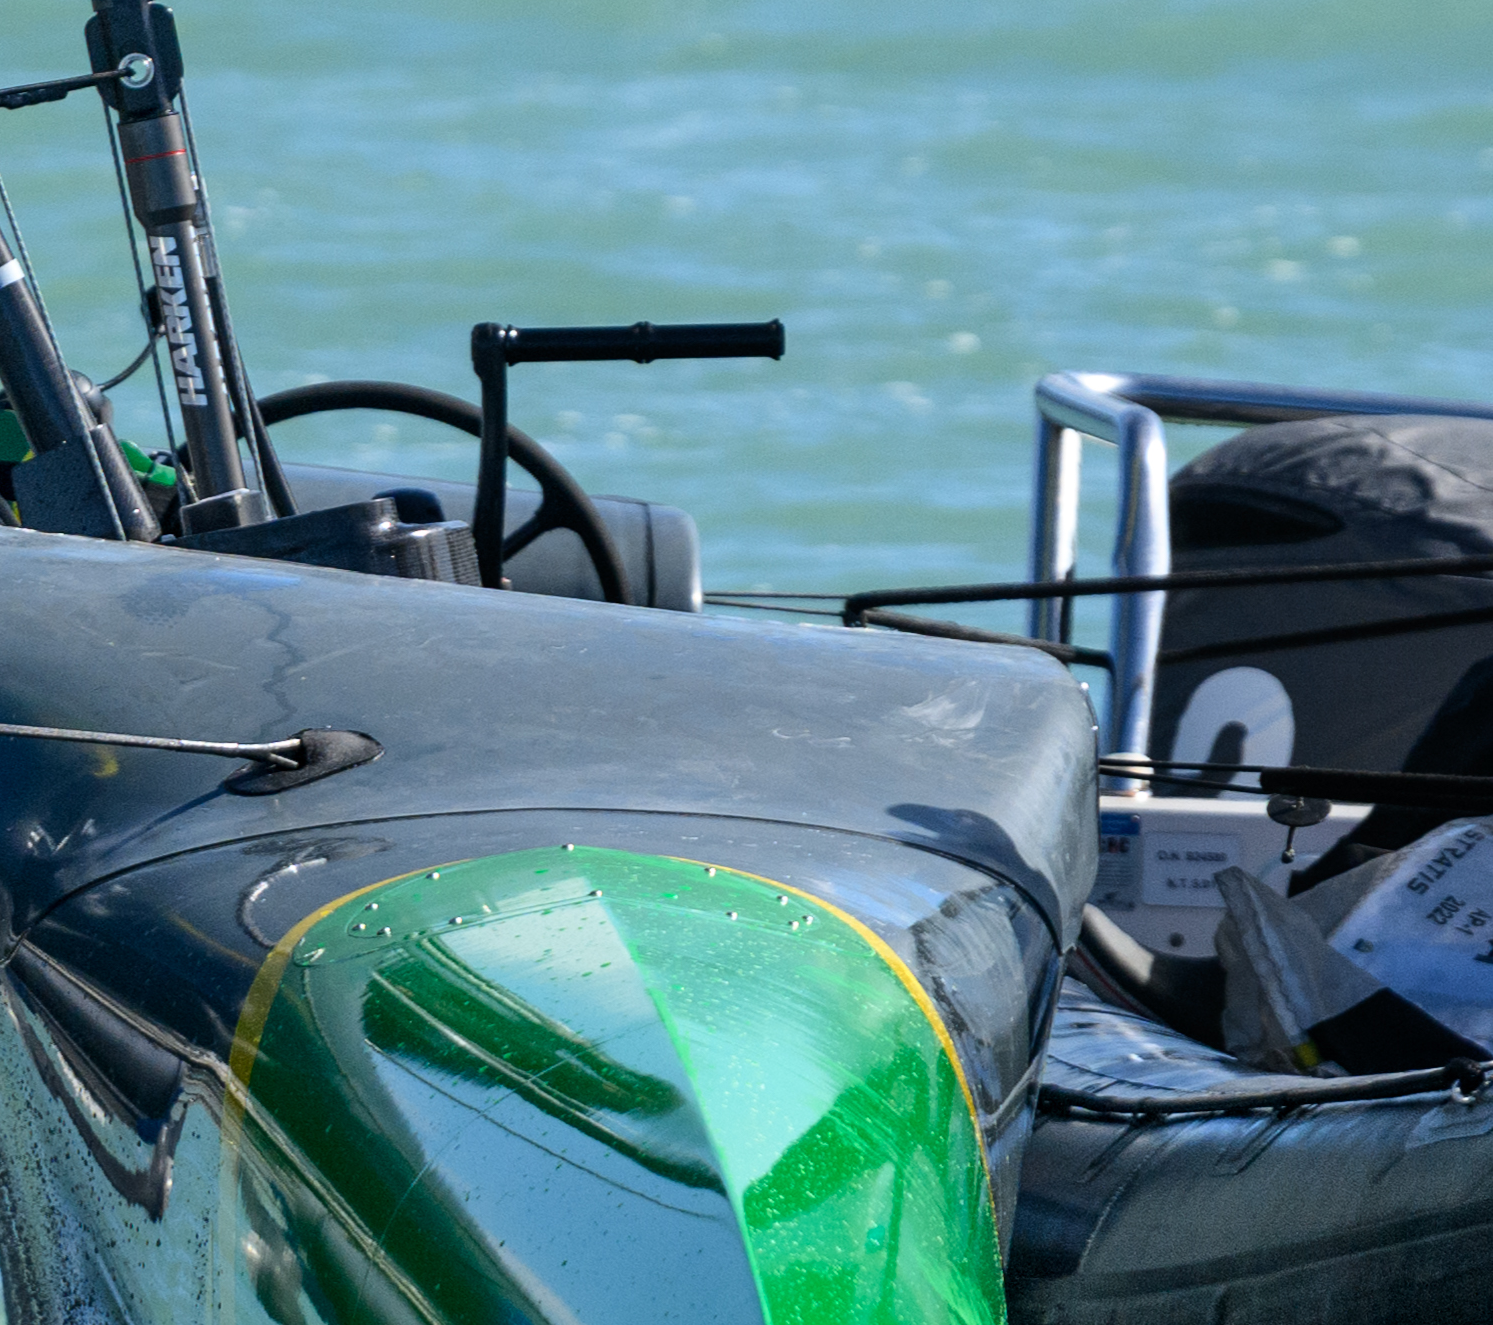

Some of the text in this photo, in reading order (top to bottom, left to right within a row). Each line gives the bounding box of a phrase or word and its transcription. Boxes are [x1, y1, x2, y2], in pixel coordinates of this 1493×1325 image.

[149, 235, 209, 406] HARKEN
[1407, 830, 1485, 895] STRATIS
[1426, 895, 1467, 925] 2022
